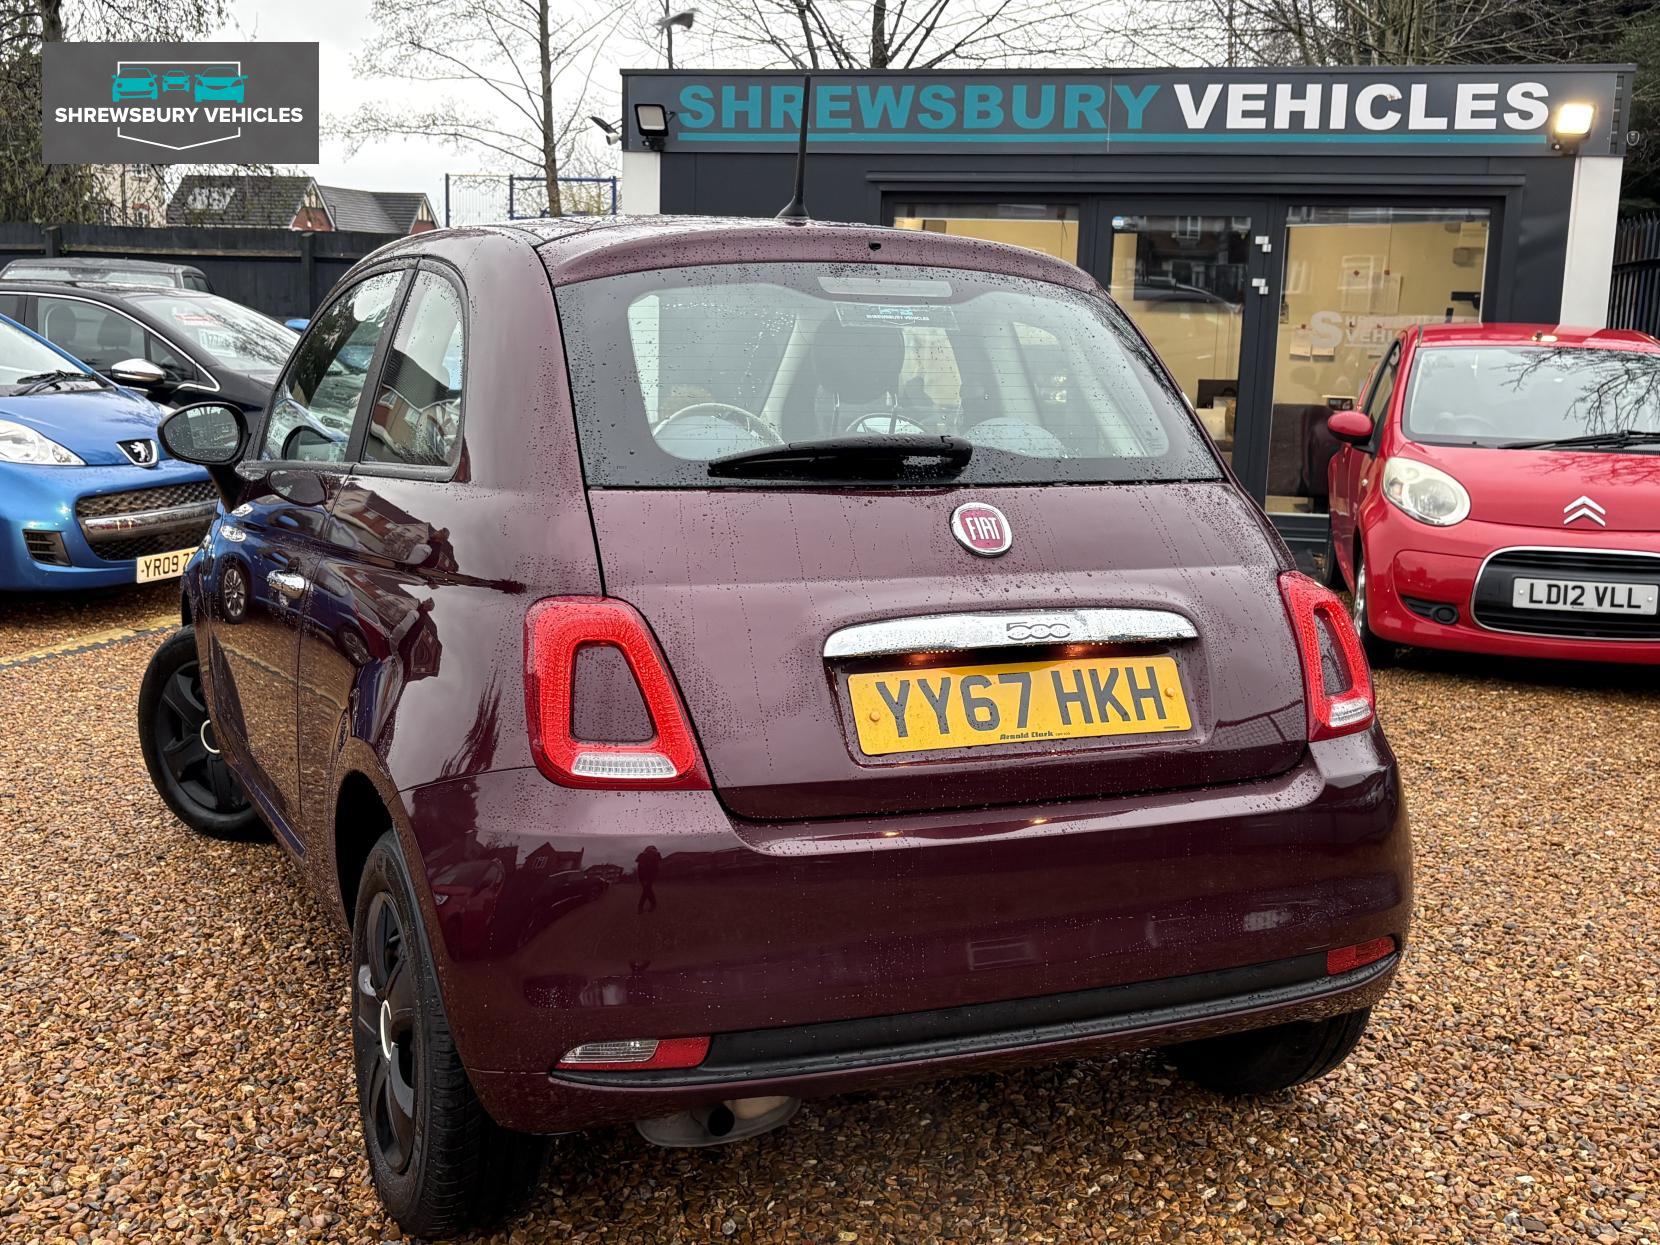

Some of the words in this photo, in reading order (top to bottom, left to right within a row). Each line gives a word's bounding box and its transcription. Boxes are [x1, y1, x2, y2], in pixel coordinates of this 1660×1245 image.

[678, 84, 1160, 129] SHREWSBURY
[1173, 82, 1550, 130] VEHICLES
[965, 516, 1001, 540] FIAT
[144, 555, 179, 578] YR09
[1529, 583, 1585, 606] LD12
[1595, 586, 1641, 609] VLL
[1005, 622, 1071, 641] 500
[876, 672, 1032, 738] YY67
[1051, 666, 1167, 726] HKH
